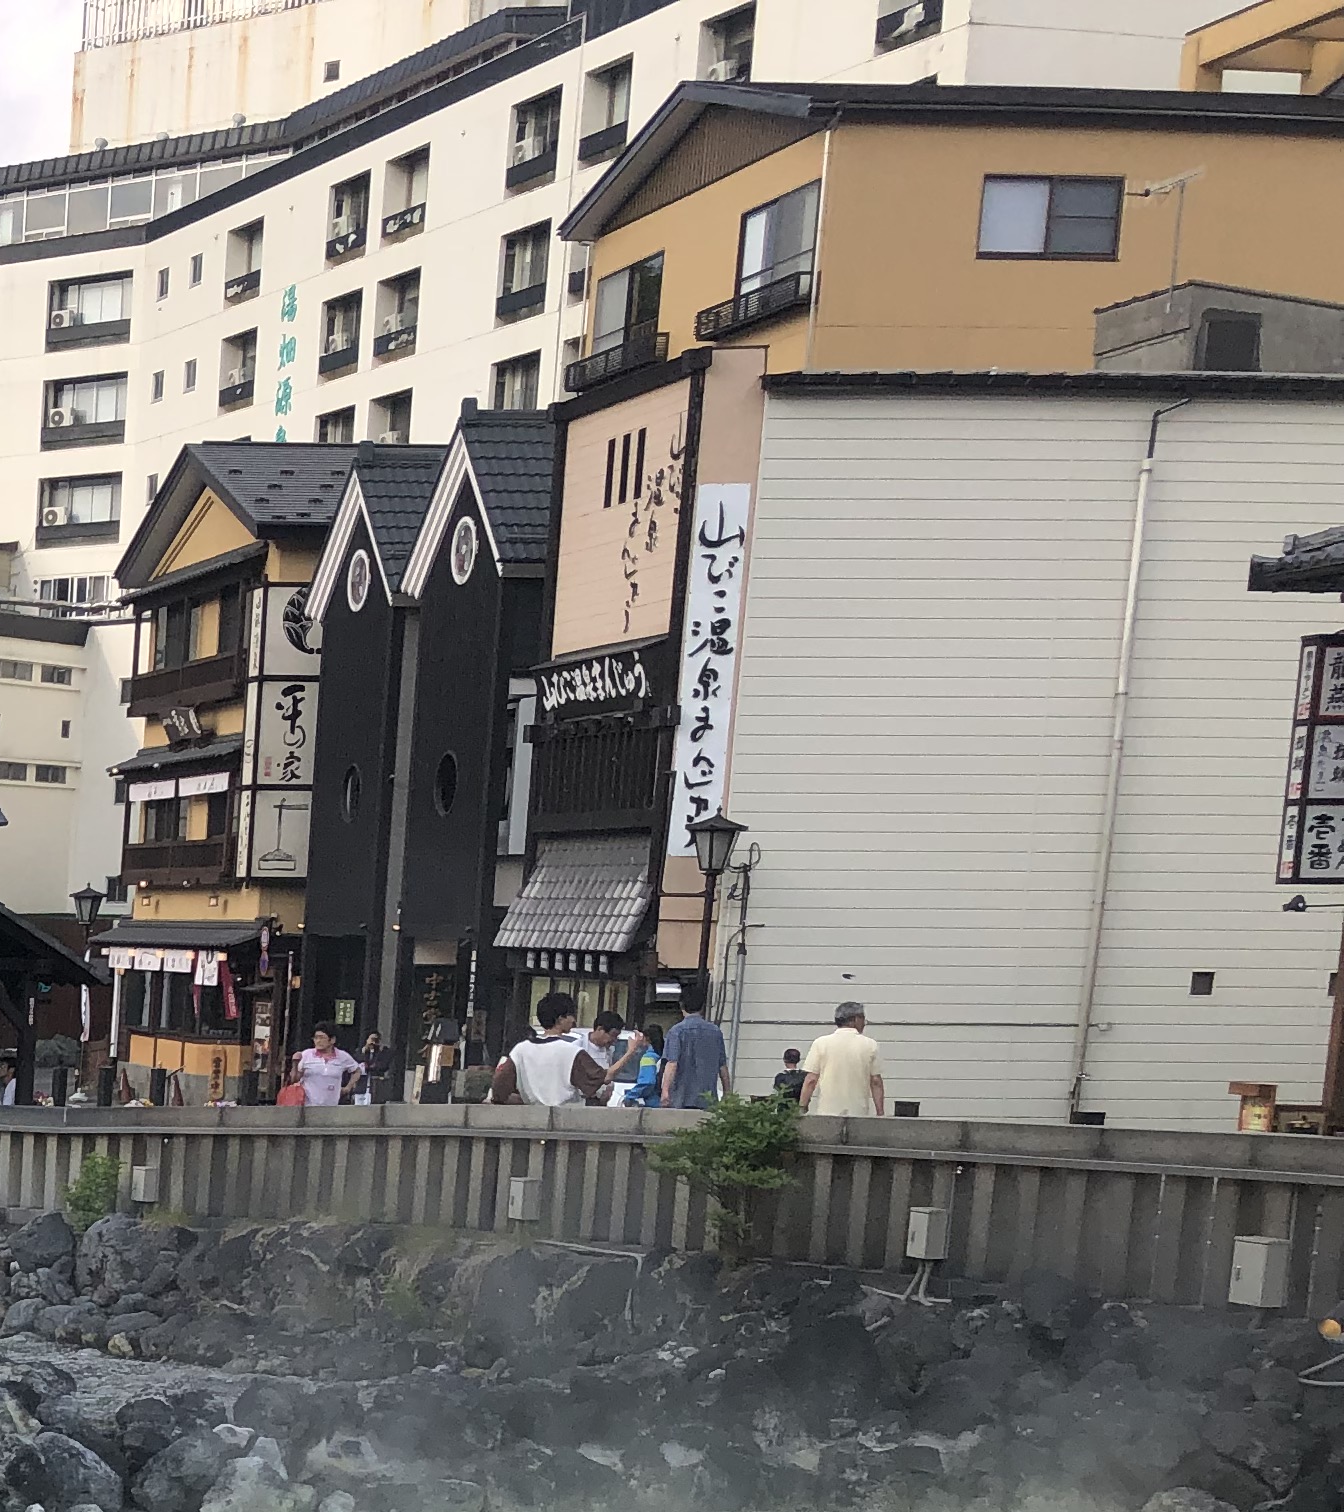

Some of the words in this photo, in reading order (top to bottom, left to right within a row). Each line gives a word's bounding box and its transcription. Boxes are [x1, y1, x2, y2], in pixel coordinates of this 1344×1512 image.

[274, 684, 306, 782] 平の家
[1307, 813, 1335, 870] 壱番
